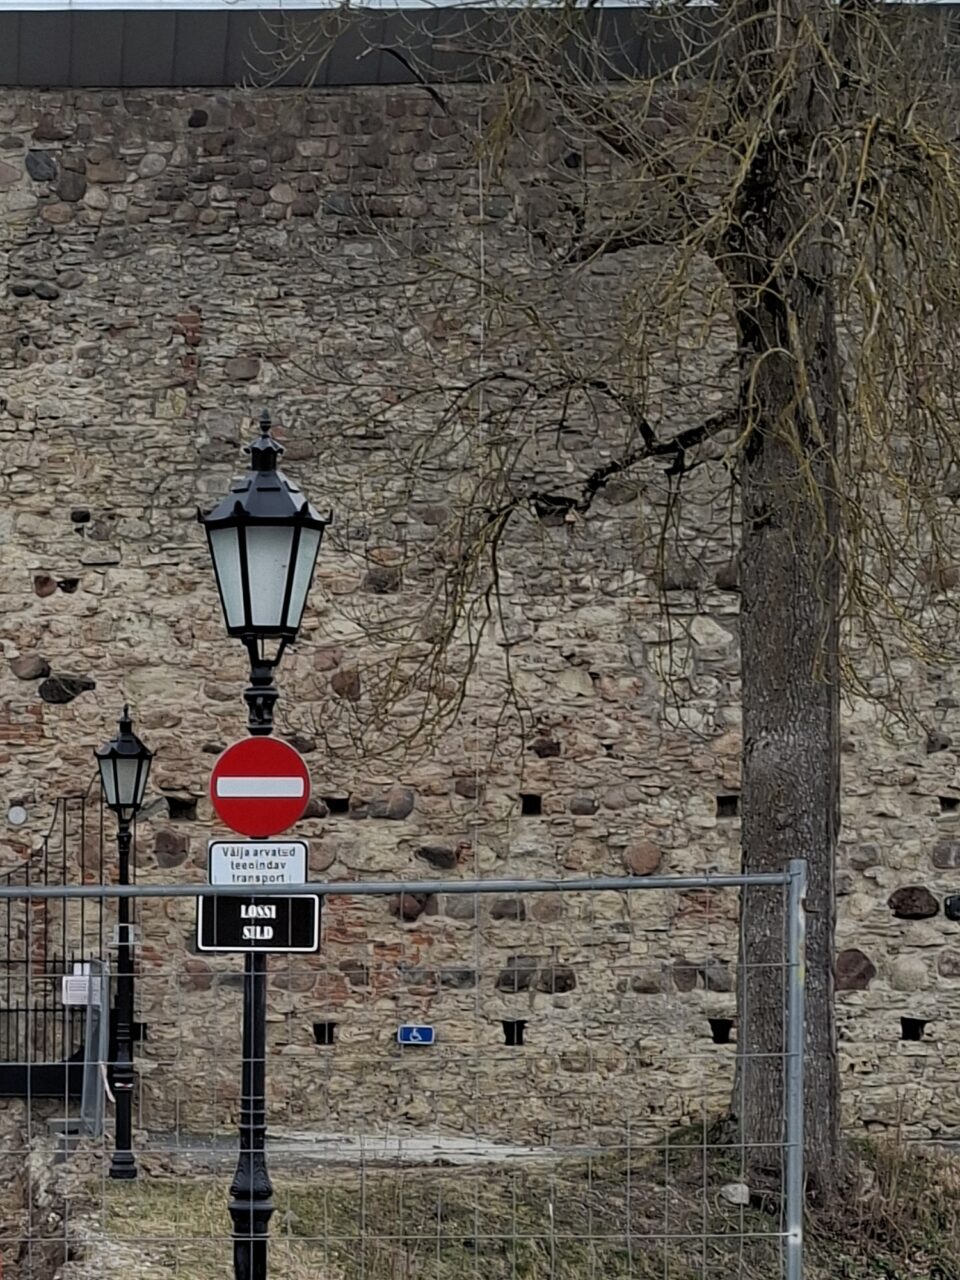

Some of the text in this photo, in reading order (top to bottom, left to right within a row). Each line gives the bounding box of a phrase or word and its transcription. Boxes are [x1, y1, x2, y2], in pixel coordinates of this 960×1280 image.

[222, 846, 250, 859] Välja
[232, 874, 285, 884] transport
[240, 904, 276, 919] LOSSI
[242, 926, 274, 940] SILD
